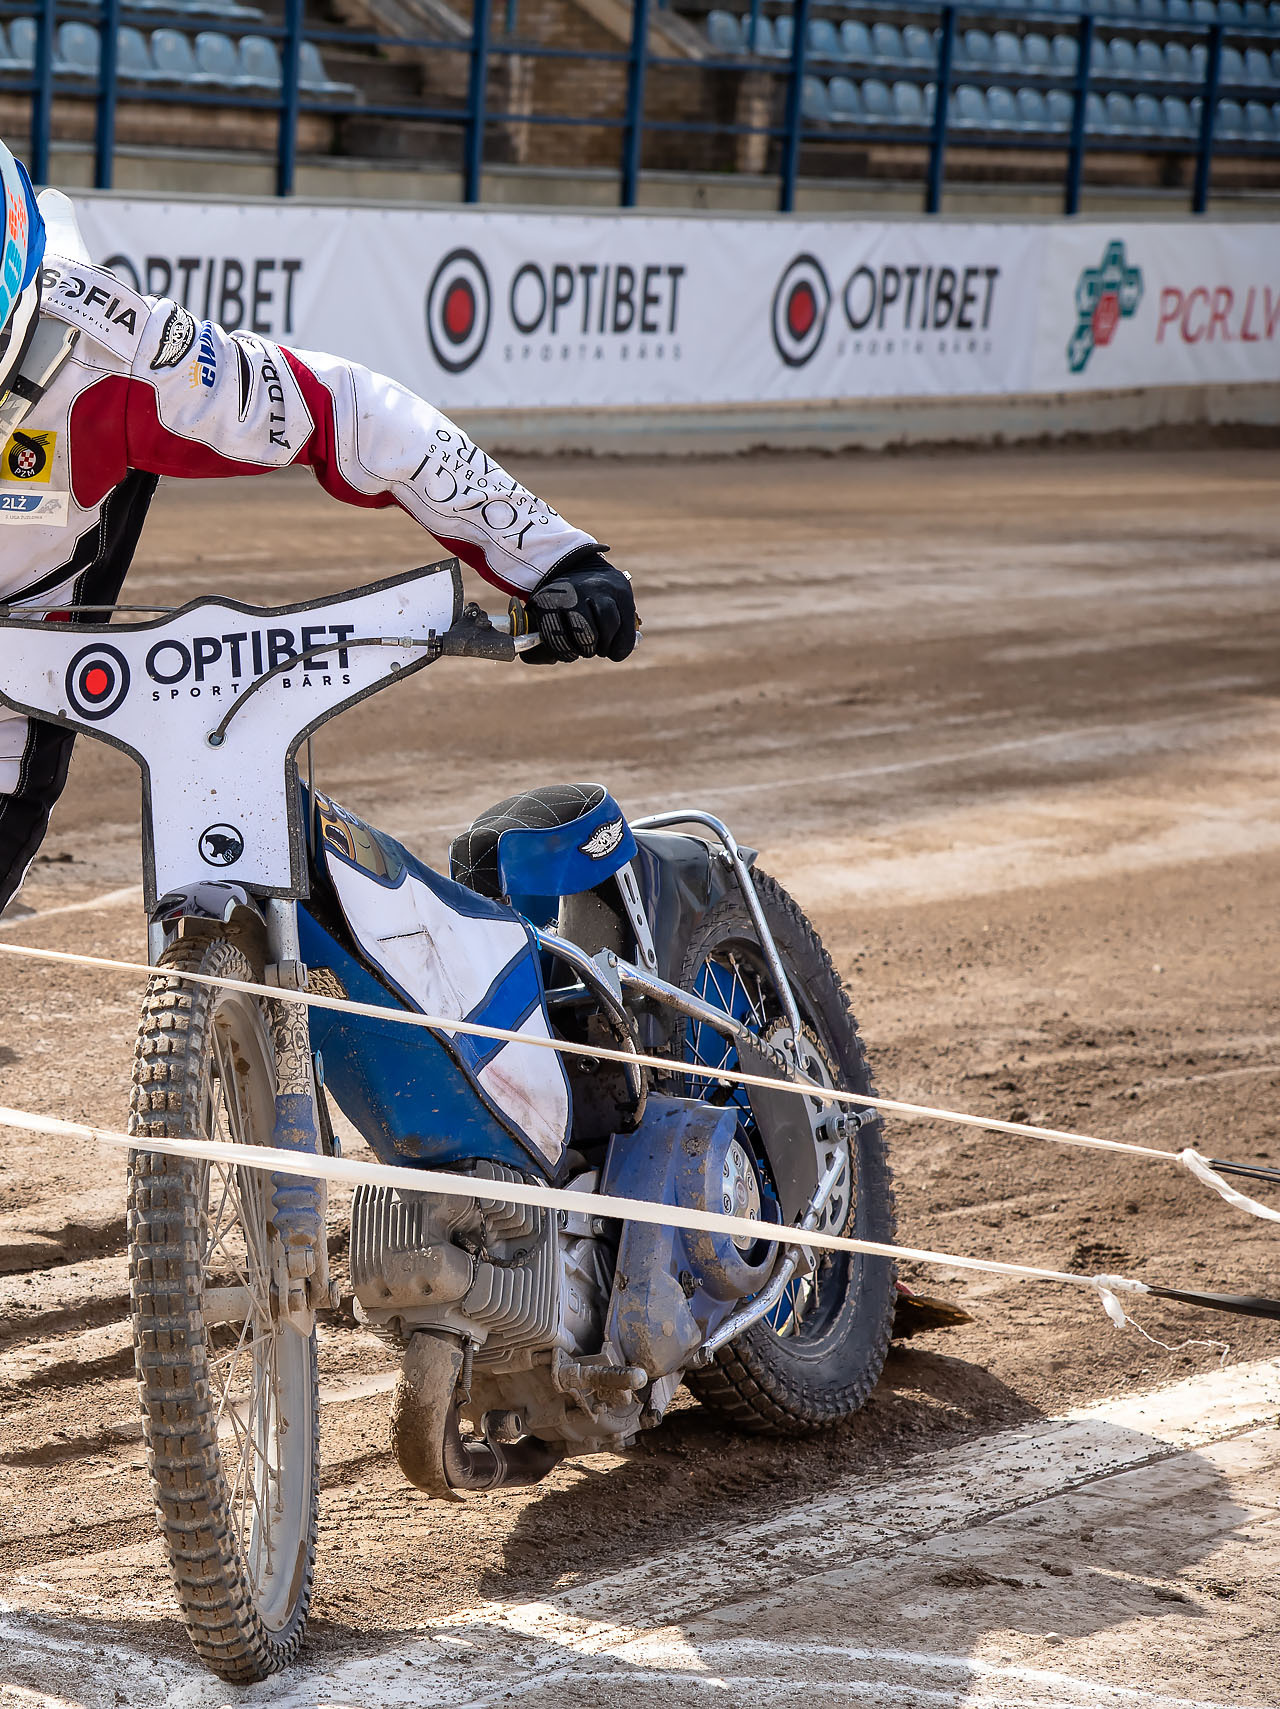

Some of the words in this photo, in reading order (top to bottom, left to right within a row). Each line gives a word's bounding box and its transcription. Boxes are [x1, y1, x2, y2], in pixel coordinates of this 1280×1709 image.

[42, 268, 138, 336] SOFIA
[46, 296, 111, 334] DAUGAVPILS
[510, 262, 686, 335] OPTIBET
[842, 264, 1000, 332] OPTIBET
[1, 495, 28, 511] 2LŻ
[14, 467, 36, 478] PZM
[409, 454, 536, 551] YOGGI
[145, 624, 355, 685] OPTIBET
[282, 674, 351, 689] BĀRS
